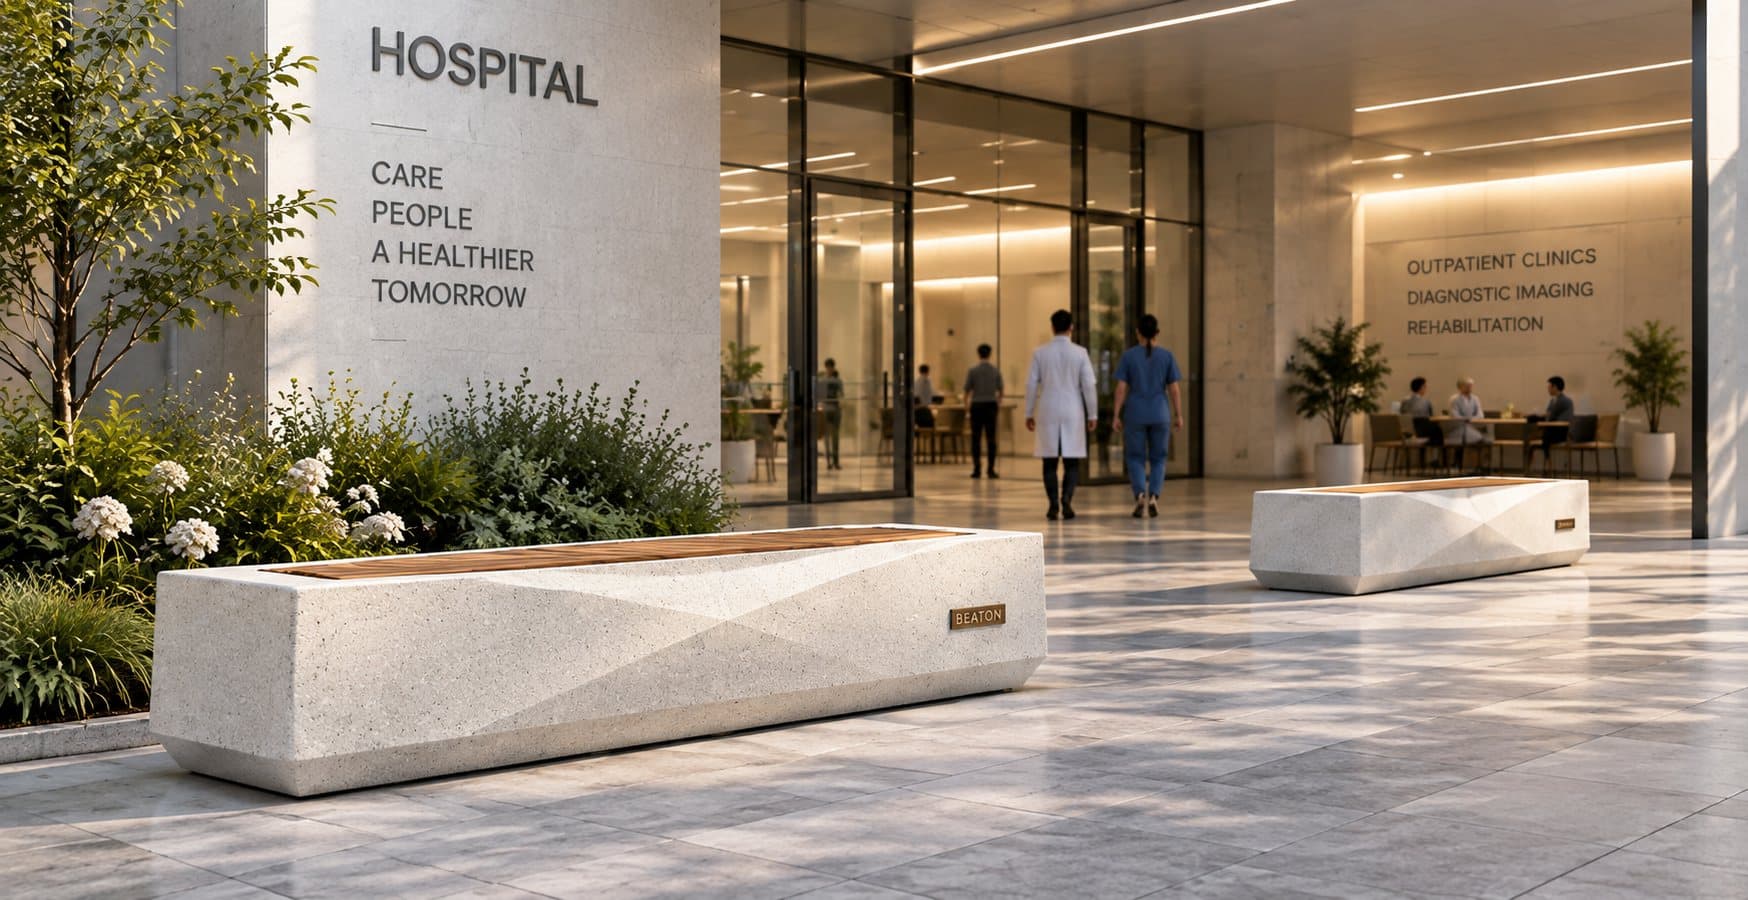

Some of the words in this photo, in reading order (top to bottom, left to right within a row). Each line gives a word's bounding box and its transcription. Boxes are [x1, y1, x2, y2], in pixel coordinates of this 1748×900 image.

[372, 26, 599, 107] HOSPITAL
[371, 161, 443, 190] CARE
[372, 200, 473, 230] PEOPLE
[371, 239, 390, 264] A
[399, 241, 534, 272] HEALTHIER
[1407, 253, 1516, 275] OUTPATIENT
[1522, 248, 1597, 268] CLINICS
[371, 279, 527, 308] TOMORROW
[1407, 286, 1511, 305] DIAGNOSTIC
[1516, 281, 1594, 300] IMAGING
[1407, 316, 1544, 335] REHABILITATION
[956, 608, 1002, 625] BEATON
